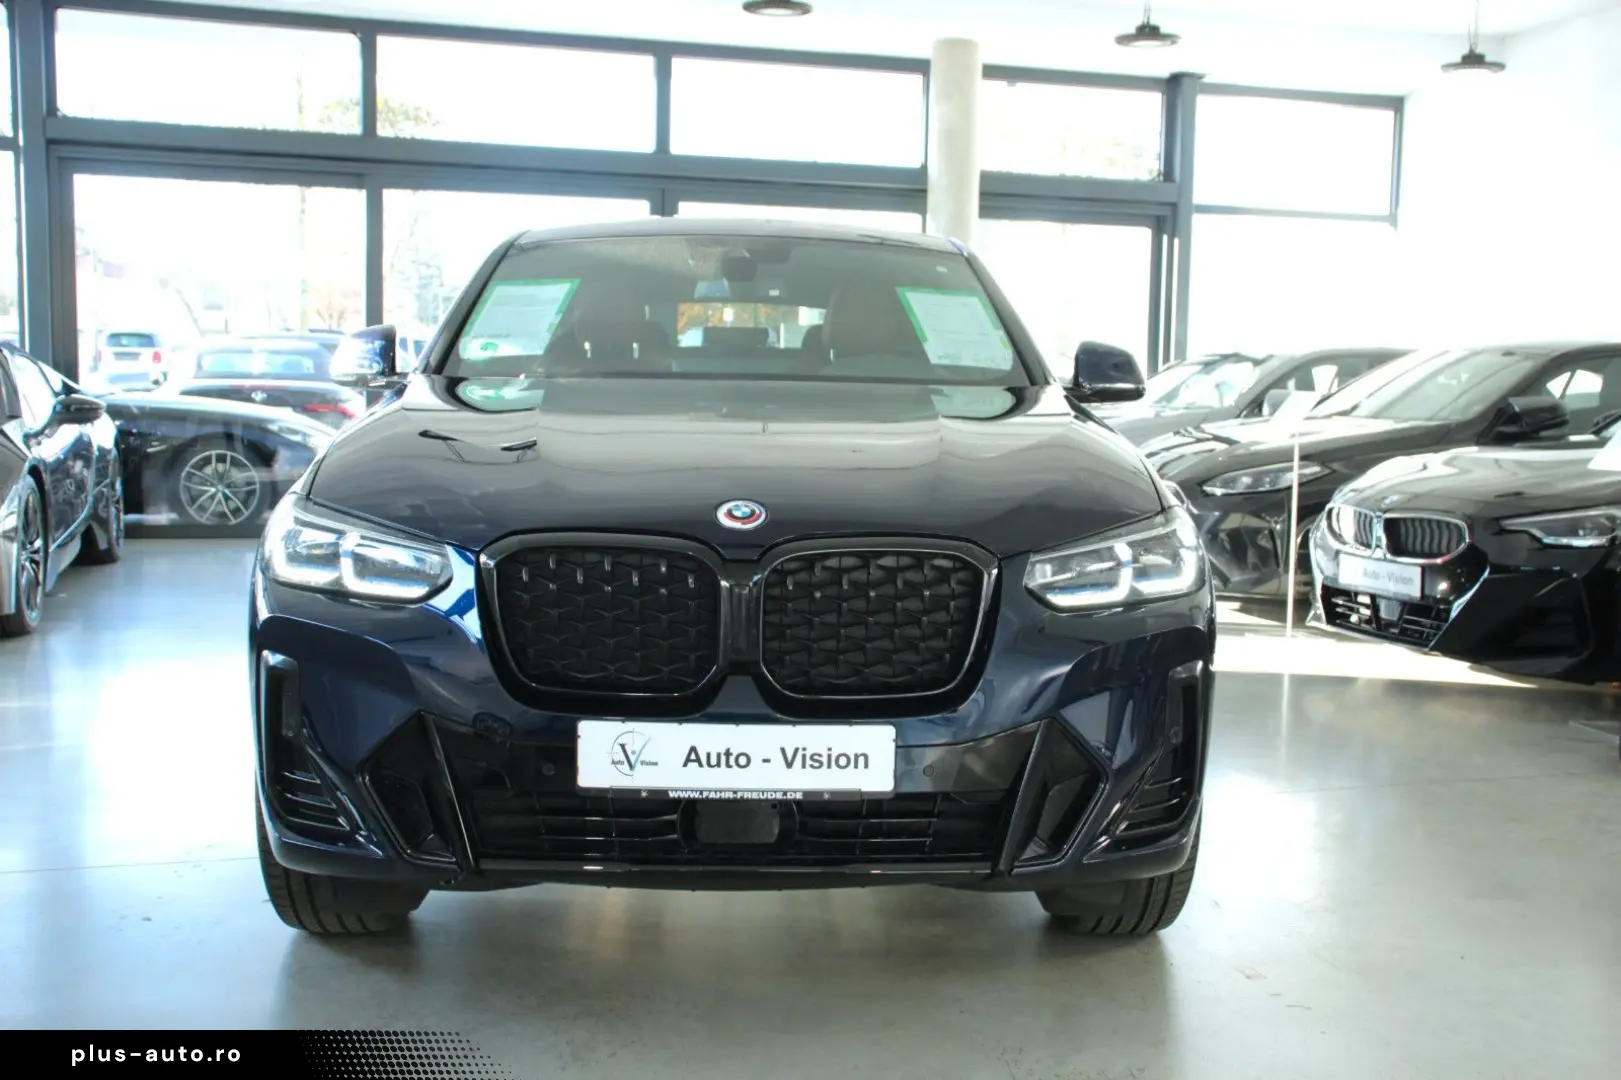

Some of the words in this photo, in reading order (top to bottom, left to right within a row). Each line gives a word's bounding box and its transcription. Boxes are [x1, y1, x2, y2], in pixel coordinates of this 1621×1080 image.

[1387, 571, 1414, 585] Vision
[682, 745, 752, 769] Auto
[780, 746, 869, 770] Vision
[668, 790, 803, 800] WWW.FAHR-FREUDE.DE
